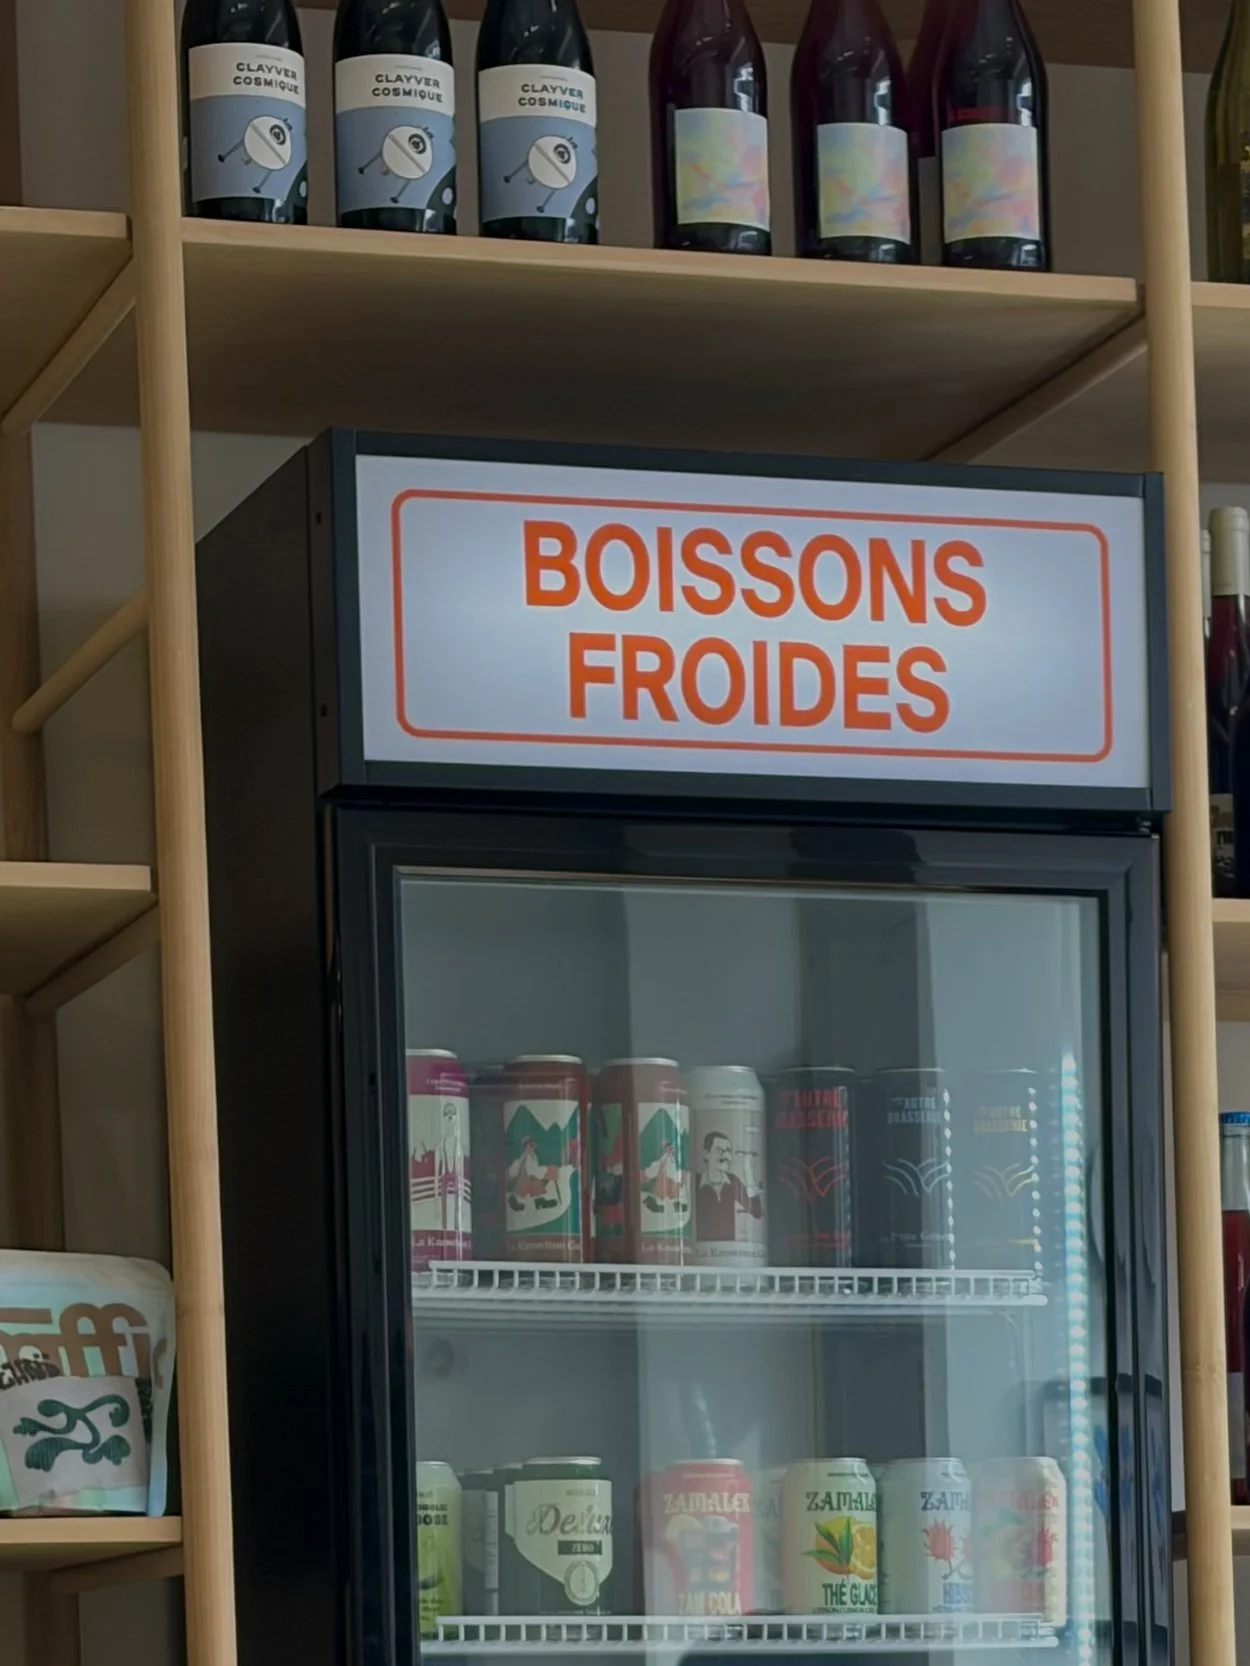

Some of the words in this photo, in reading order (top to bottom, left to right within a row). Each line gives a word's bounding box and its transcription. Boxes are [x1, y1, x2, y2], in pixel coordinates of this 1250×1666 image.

[236, 62, 298, 81] CLAYVER
[375, 72, 441, 89] CLAYVER
[233, 75, 299, 95] COSMIQUE
[372, 86, 443, 103] COSMIQUE
[520, 82, 584, 99] CLAYVER
[517, 96, 587, 113] COSMIQUE
[522, 518, 987, 628] BOISSONS
[567, 631, 951, 734] FROIDES
[822, 1578, 848, 1606] THÉ
[709, 1592, 742, 1615] COLA
